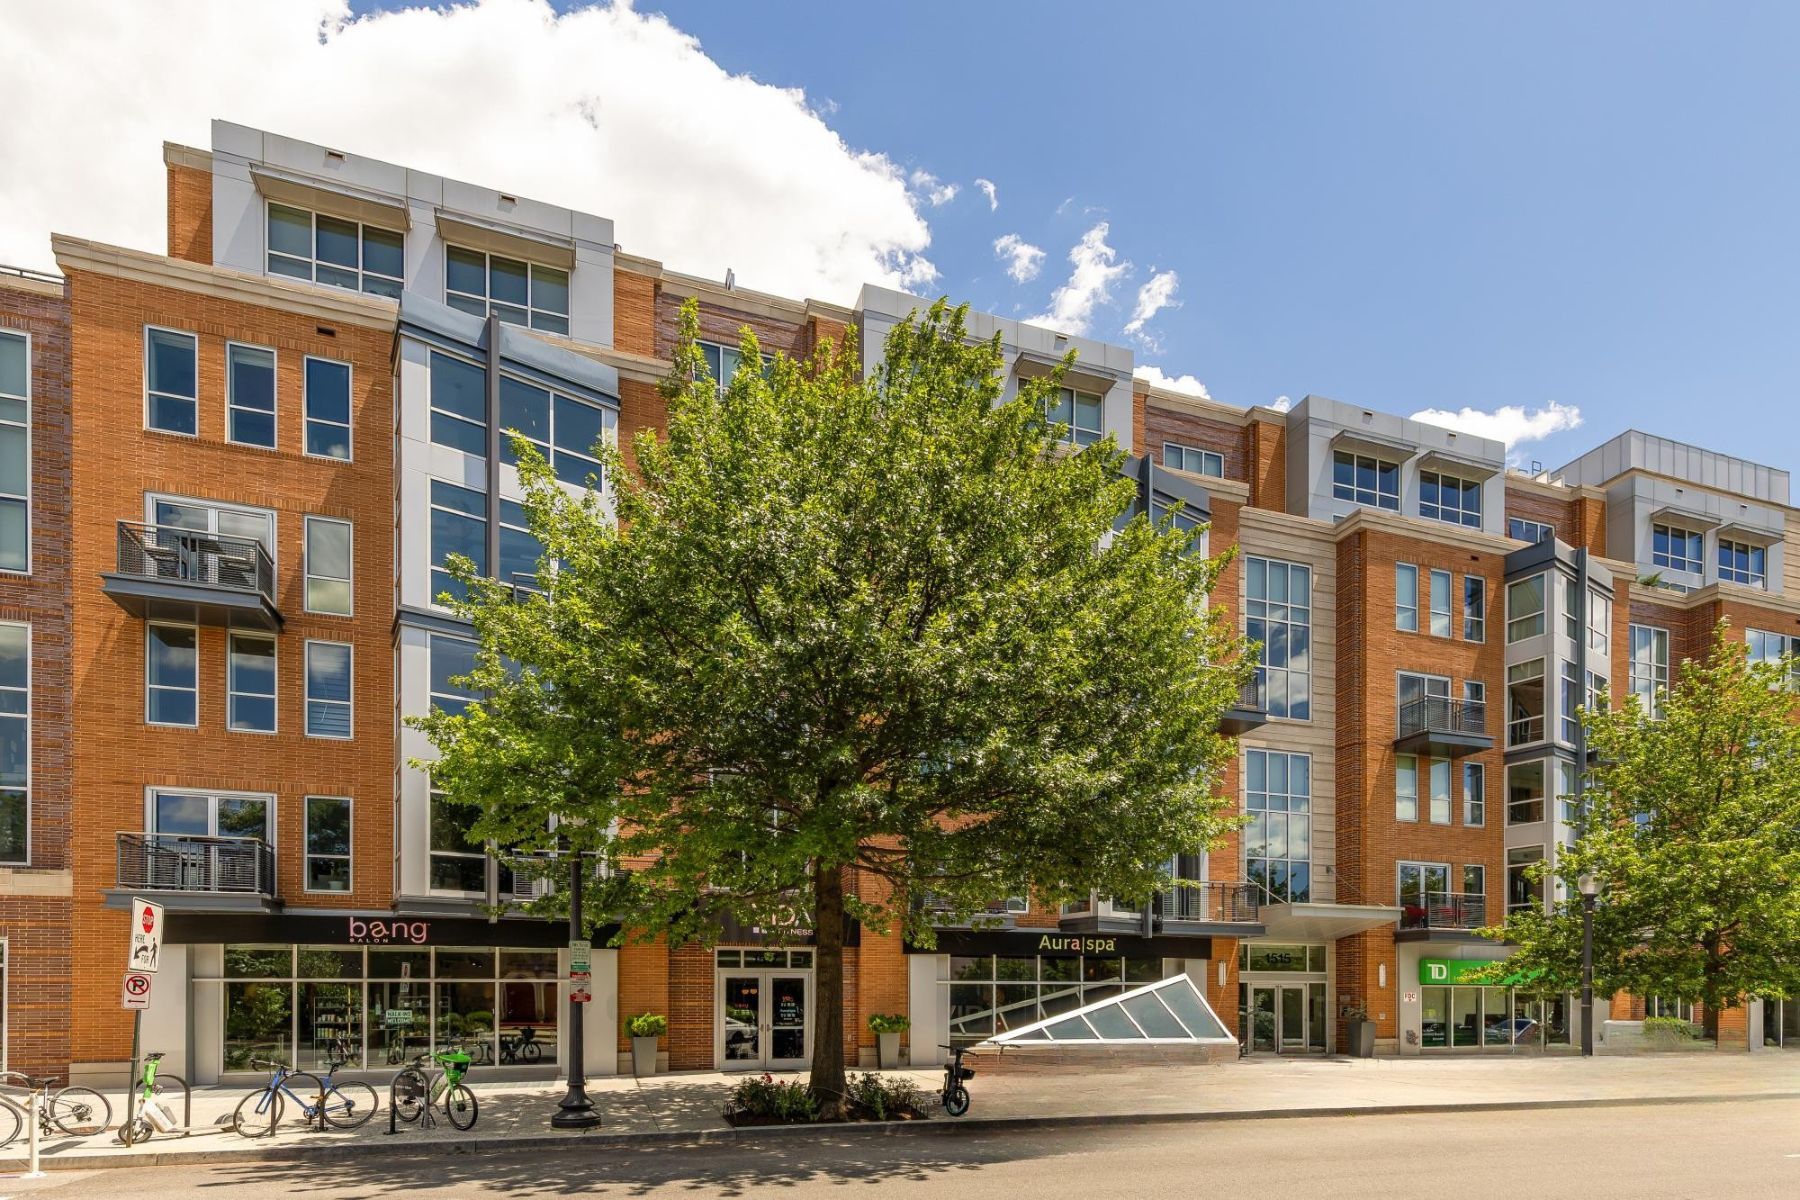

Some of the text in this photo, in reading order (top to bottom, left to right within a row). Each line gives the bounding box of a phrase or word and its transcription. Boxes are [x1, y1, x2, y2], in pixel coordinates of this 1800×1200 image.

[751, 904, 813, 928] IDA
[349, 916, 427, 943] bang
[134, 934, 145, 944] HERE
[141, 954, 150, 964] FOR
[1265, 952, 1292, 964] 1515
[1427, 963, 1447, 979] TD
